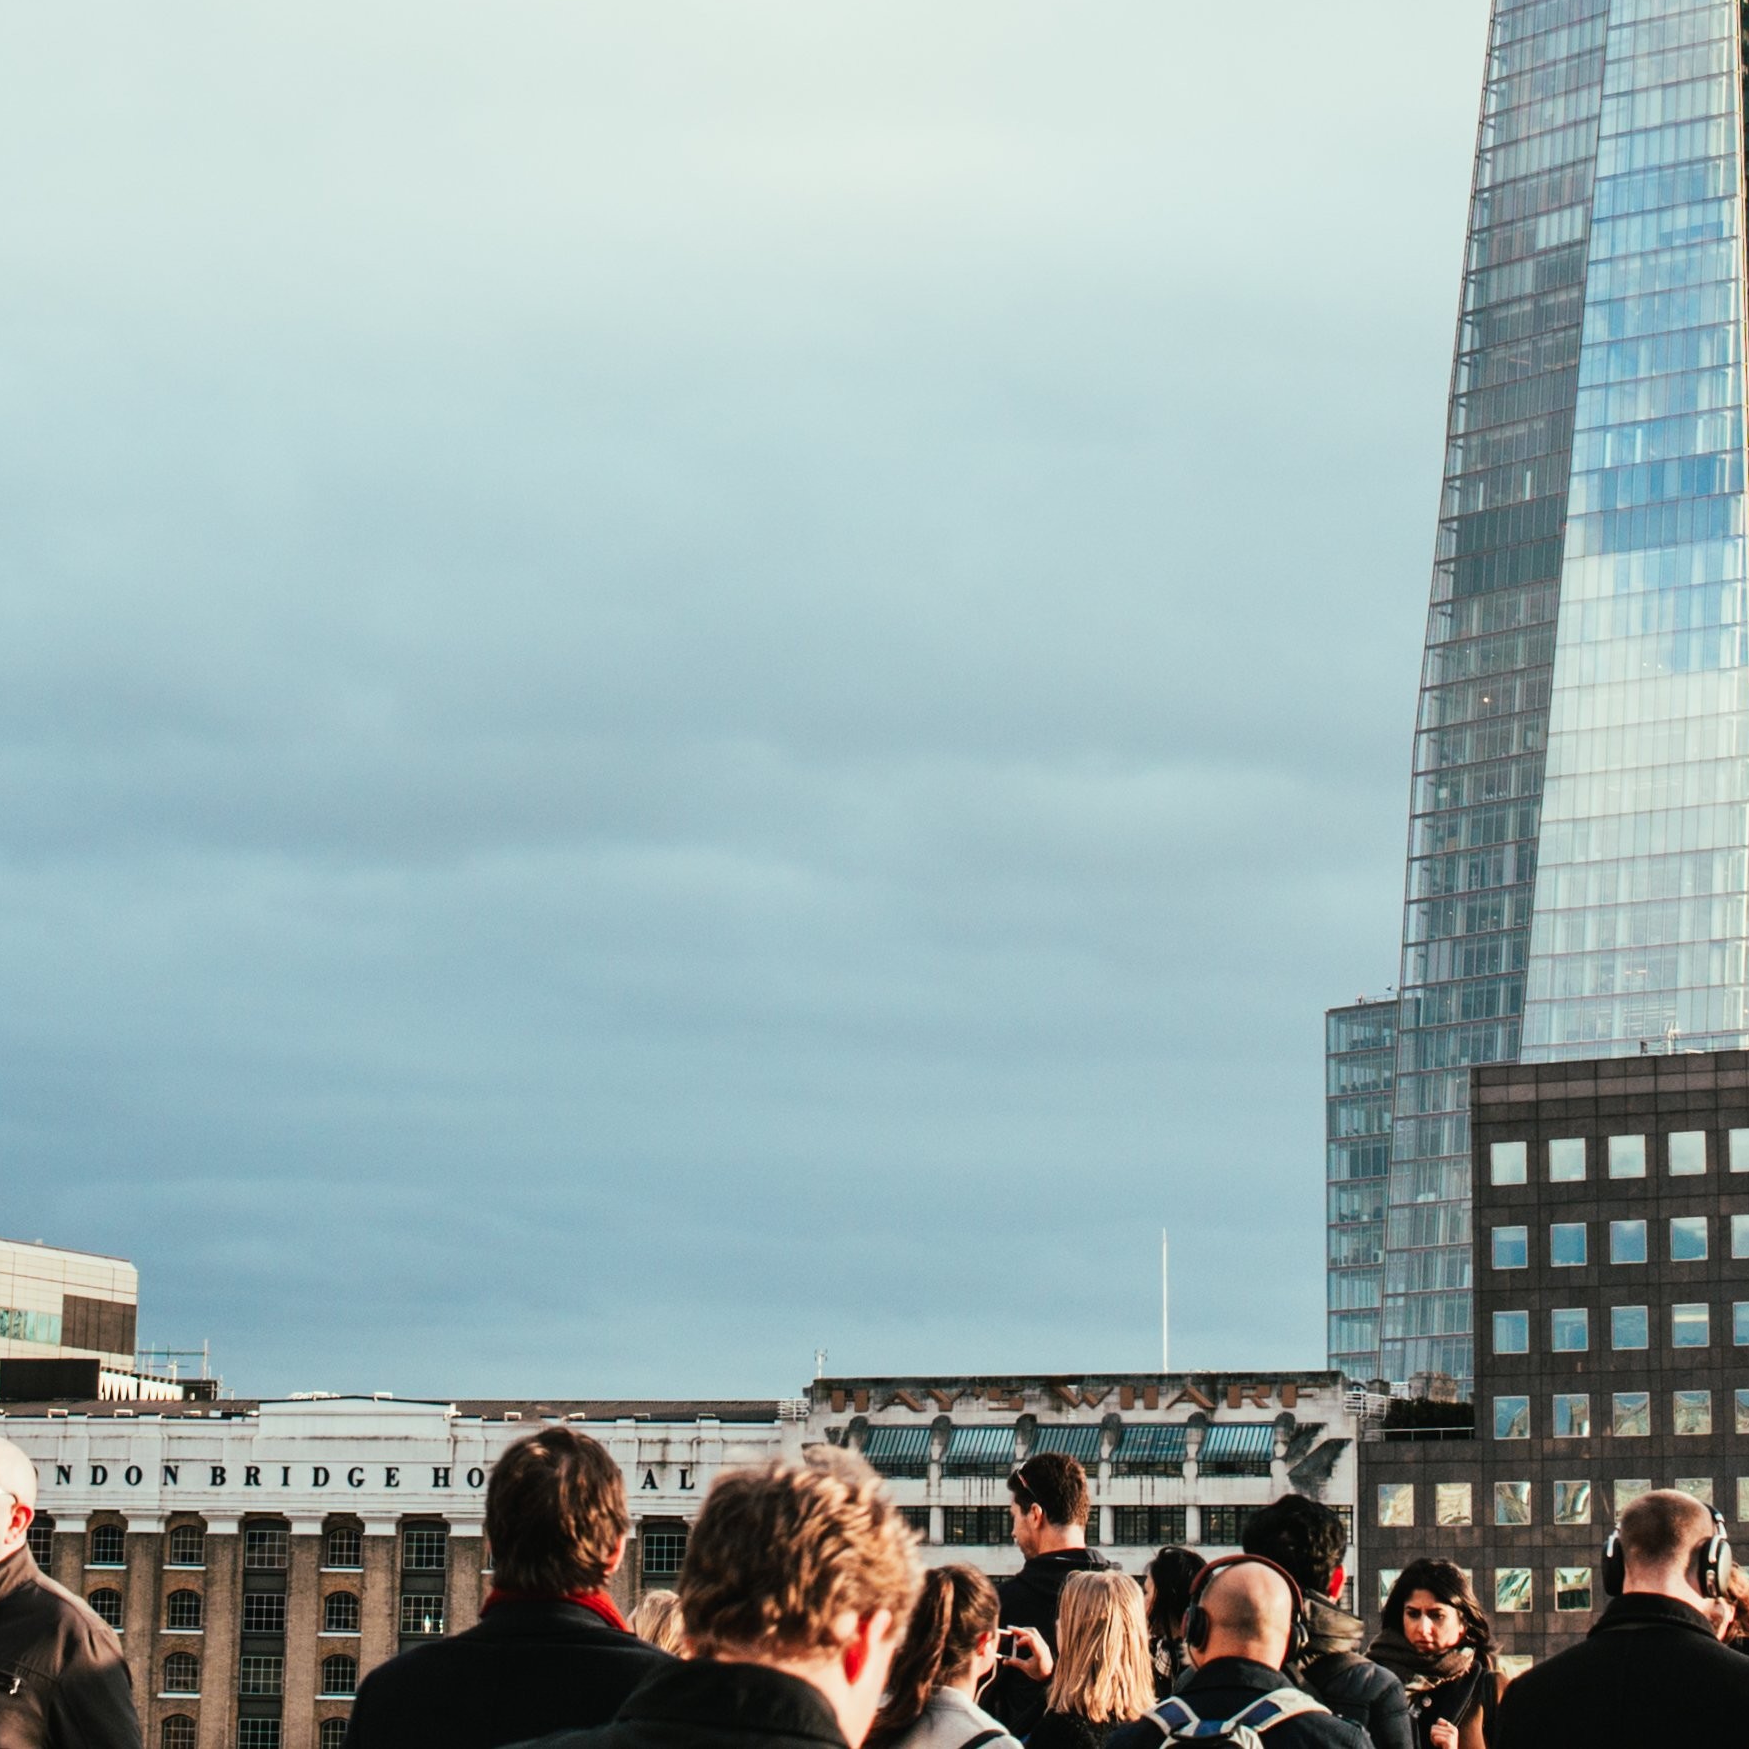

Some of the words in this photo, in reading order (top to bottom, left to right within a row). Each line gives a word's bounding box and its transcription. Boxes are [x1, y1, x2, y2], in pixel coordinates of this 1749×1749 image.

[831, 1386, 1025, 1413] HAY'S
[1052, 1383, 1330, 1410] WHARF
[33, 1464, 179, 1486] NDON
[210, 1465, 400, 1488] BRIDGE
[432, 1467, 695, 1490] HOAL
